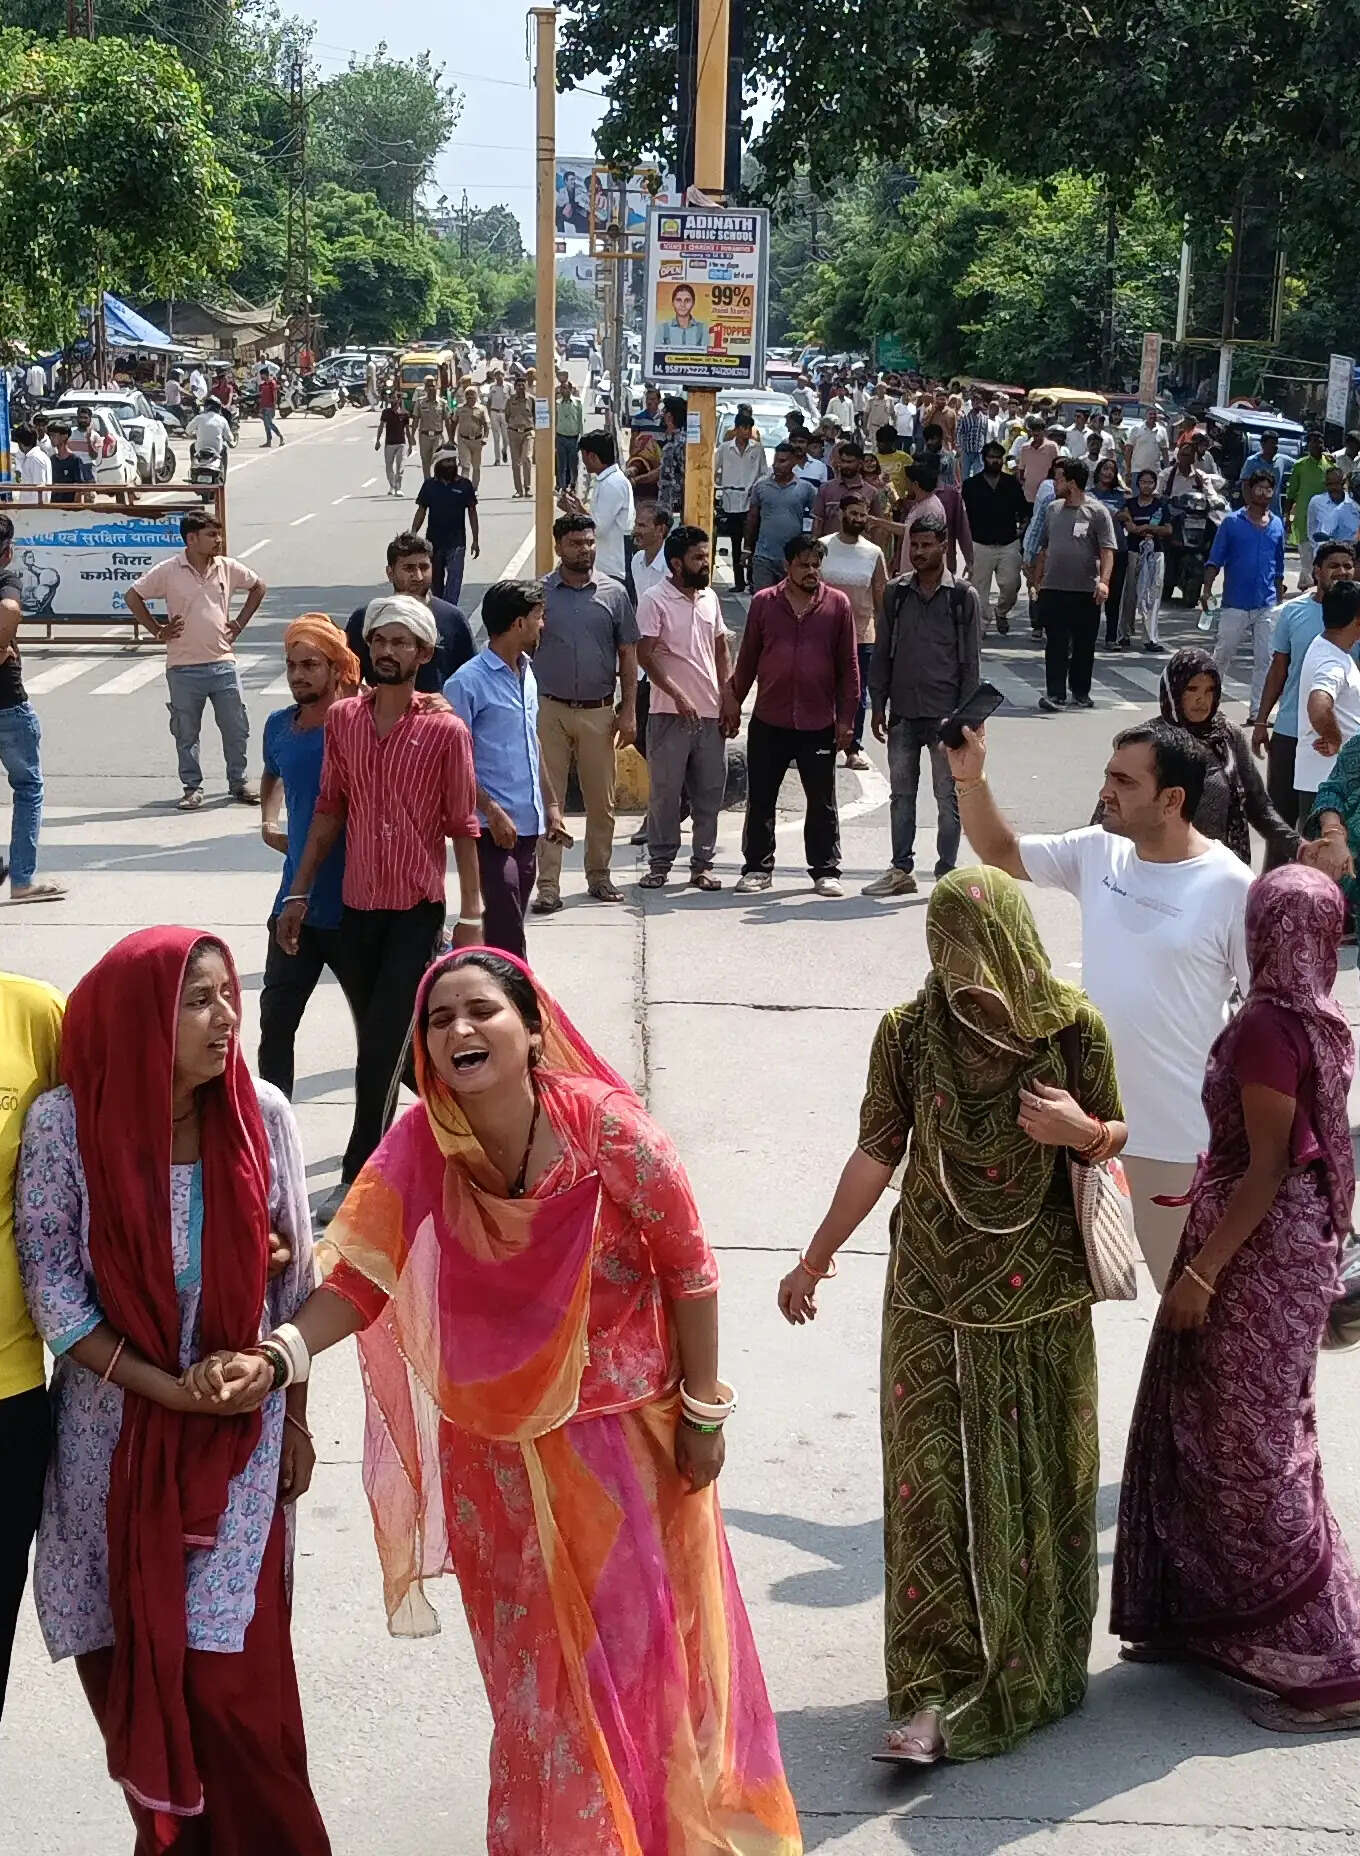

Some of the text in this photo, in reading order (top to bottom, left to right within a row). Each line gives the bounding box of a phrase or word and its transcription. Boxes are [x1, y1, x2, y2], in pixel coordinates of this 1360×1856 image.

[685, 216, 753, 231] ADINATH
[683, 229, 753, 241] PUBLIC SCHOOL
[711, 286, 751, 307] 99%
[81, 530, 127, 546] सुरक्षित
